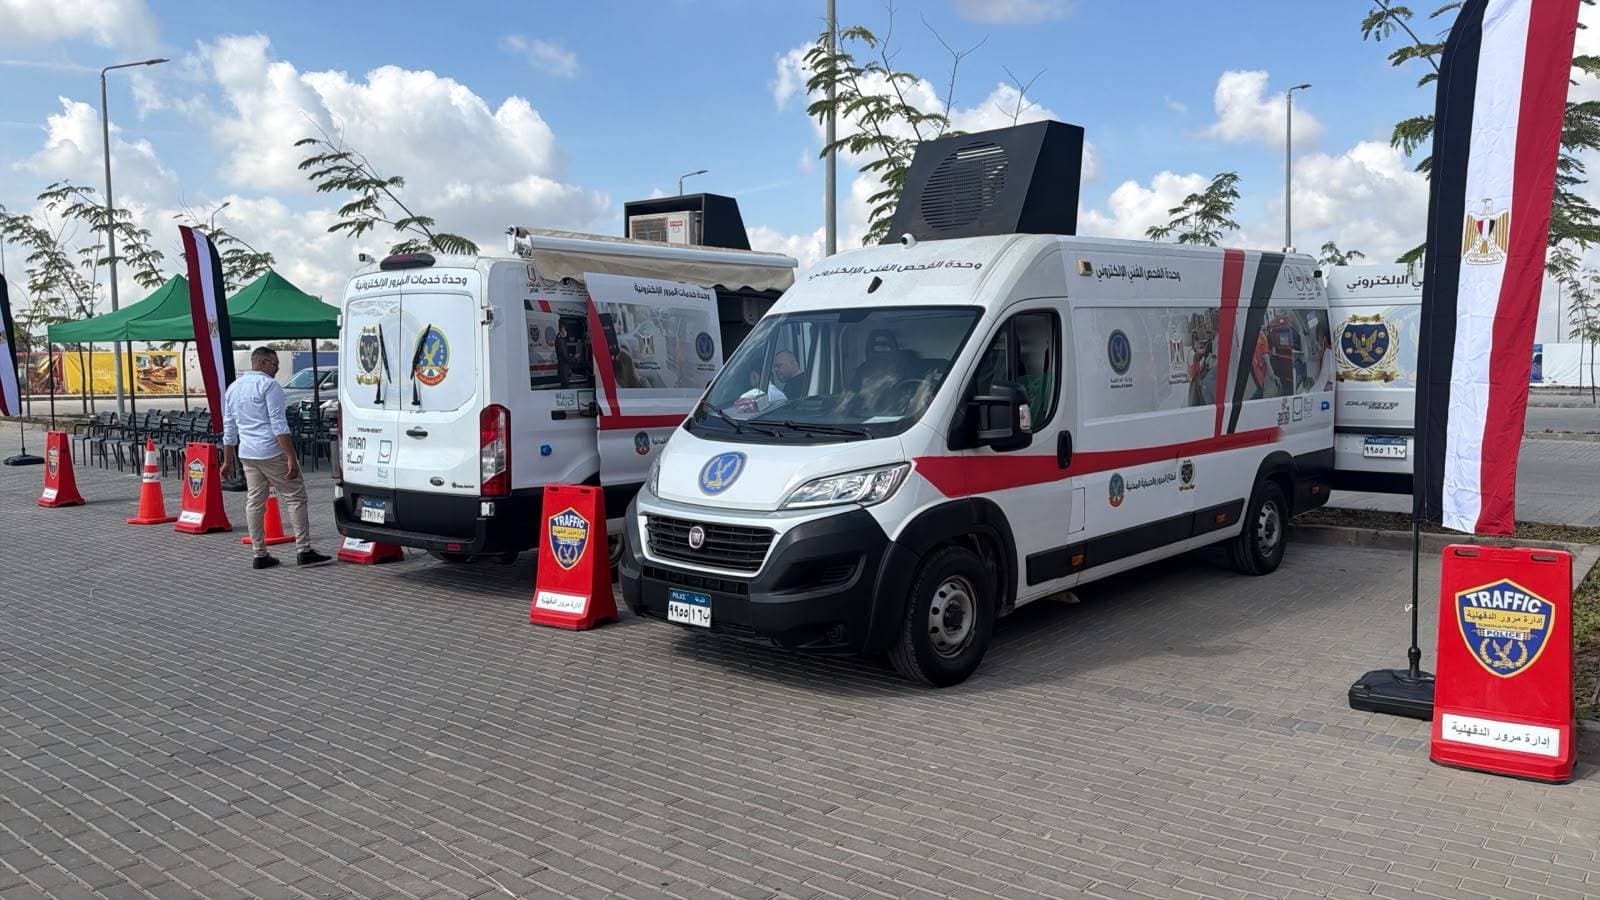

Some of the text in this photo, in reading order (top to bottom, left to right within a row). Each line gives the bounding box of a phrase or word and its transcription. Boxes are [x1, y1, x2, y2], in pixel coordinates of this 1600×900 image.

[899, 261, 943, 273] الفحص
[945, 260, 982, 270] وحدة
[1127, 264, 1144, 284] الفني
[1144, 266, 1165, 280] الفحص
[1165, 267, 1181, 282] وحدة
[388, 275, 410, 288] المرور
[411, 274, 440, 286] خدمات
[442, 274, 467, 286] وحدة
[1346, 275, 1409, 293] الإلكتروني
[664, 287, 678, 297] المرور
[679, 288, 697, 298] خدمات
[697, 291, 710, 301] وحدة
[554, 514, 585, 528] TRAFFIC
[1465, 590, 1542, 613] TRAFFIC
[670, 604, 688, 618] ٩٩٥٥
[1466, 610, 1497, 621] الدقهلية
[1523, 616, 1543, 626] إدارة
[1486, 630, 1521, 638] POLICE
[1451, 721, 1550, 749] إدارة مرور الدقهلية
